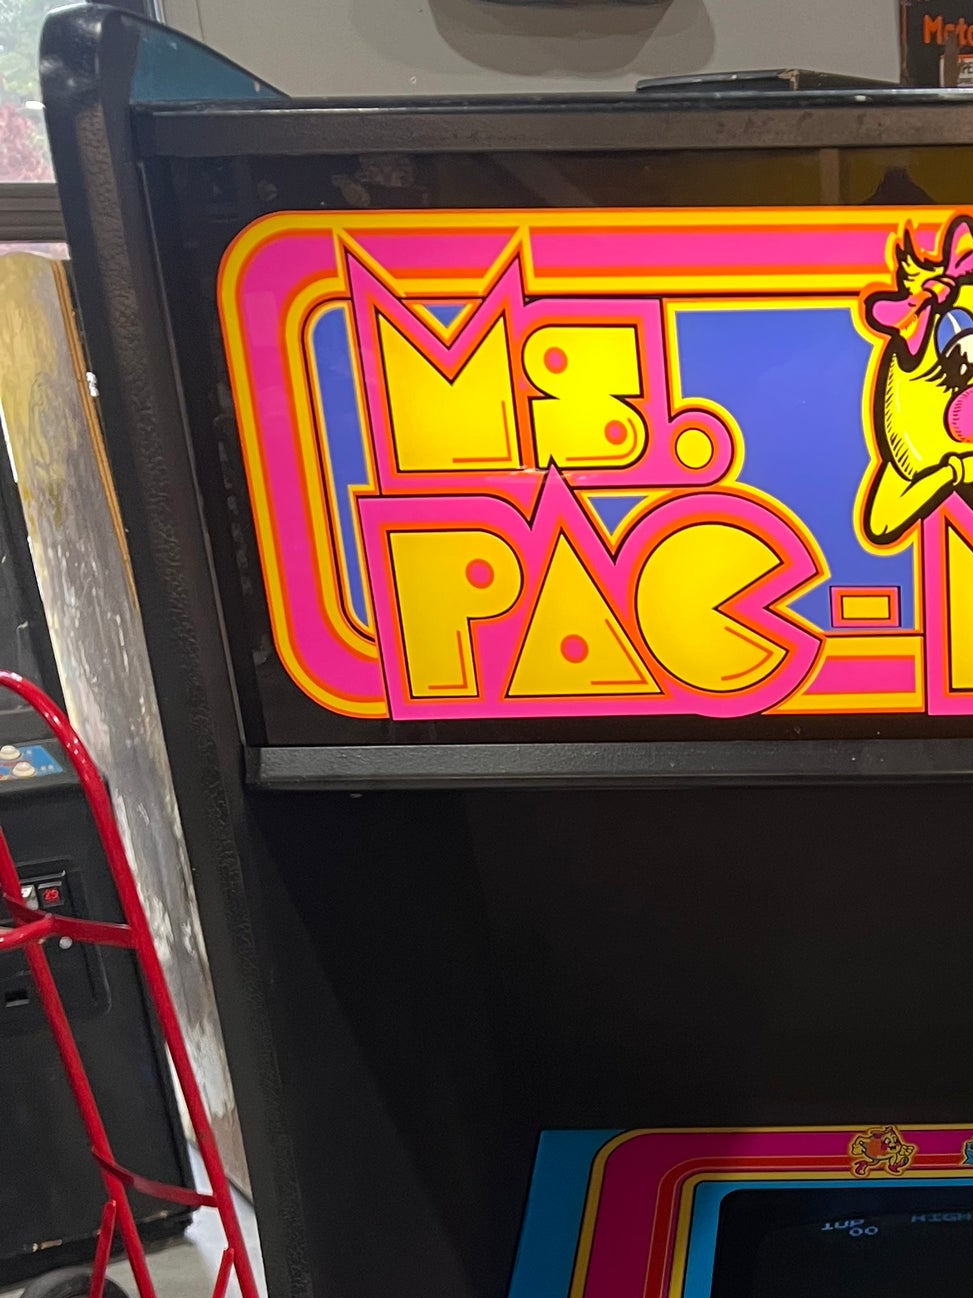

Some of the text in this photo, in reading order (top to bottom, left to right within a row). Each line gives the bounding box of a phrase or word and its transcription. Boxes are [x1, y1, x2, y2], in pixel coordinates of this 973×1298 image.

[821, 1218, 865, 1231] 1UP
[911, 1213, 973, 1223] HIGH
[849, 1226, 878, 1236] 00
